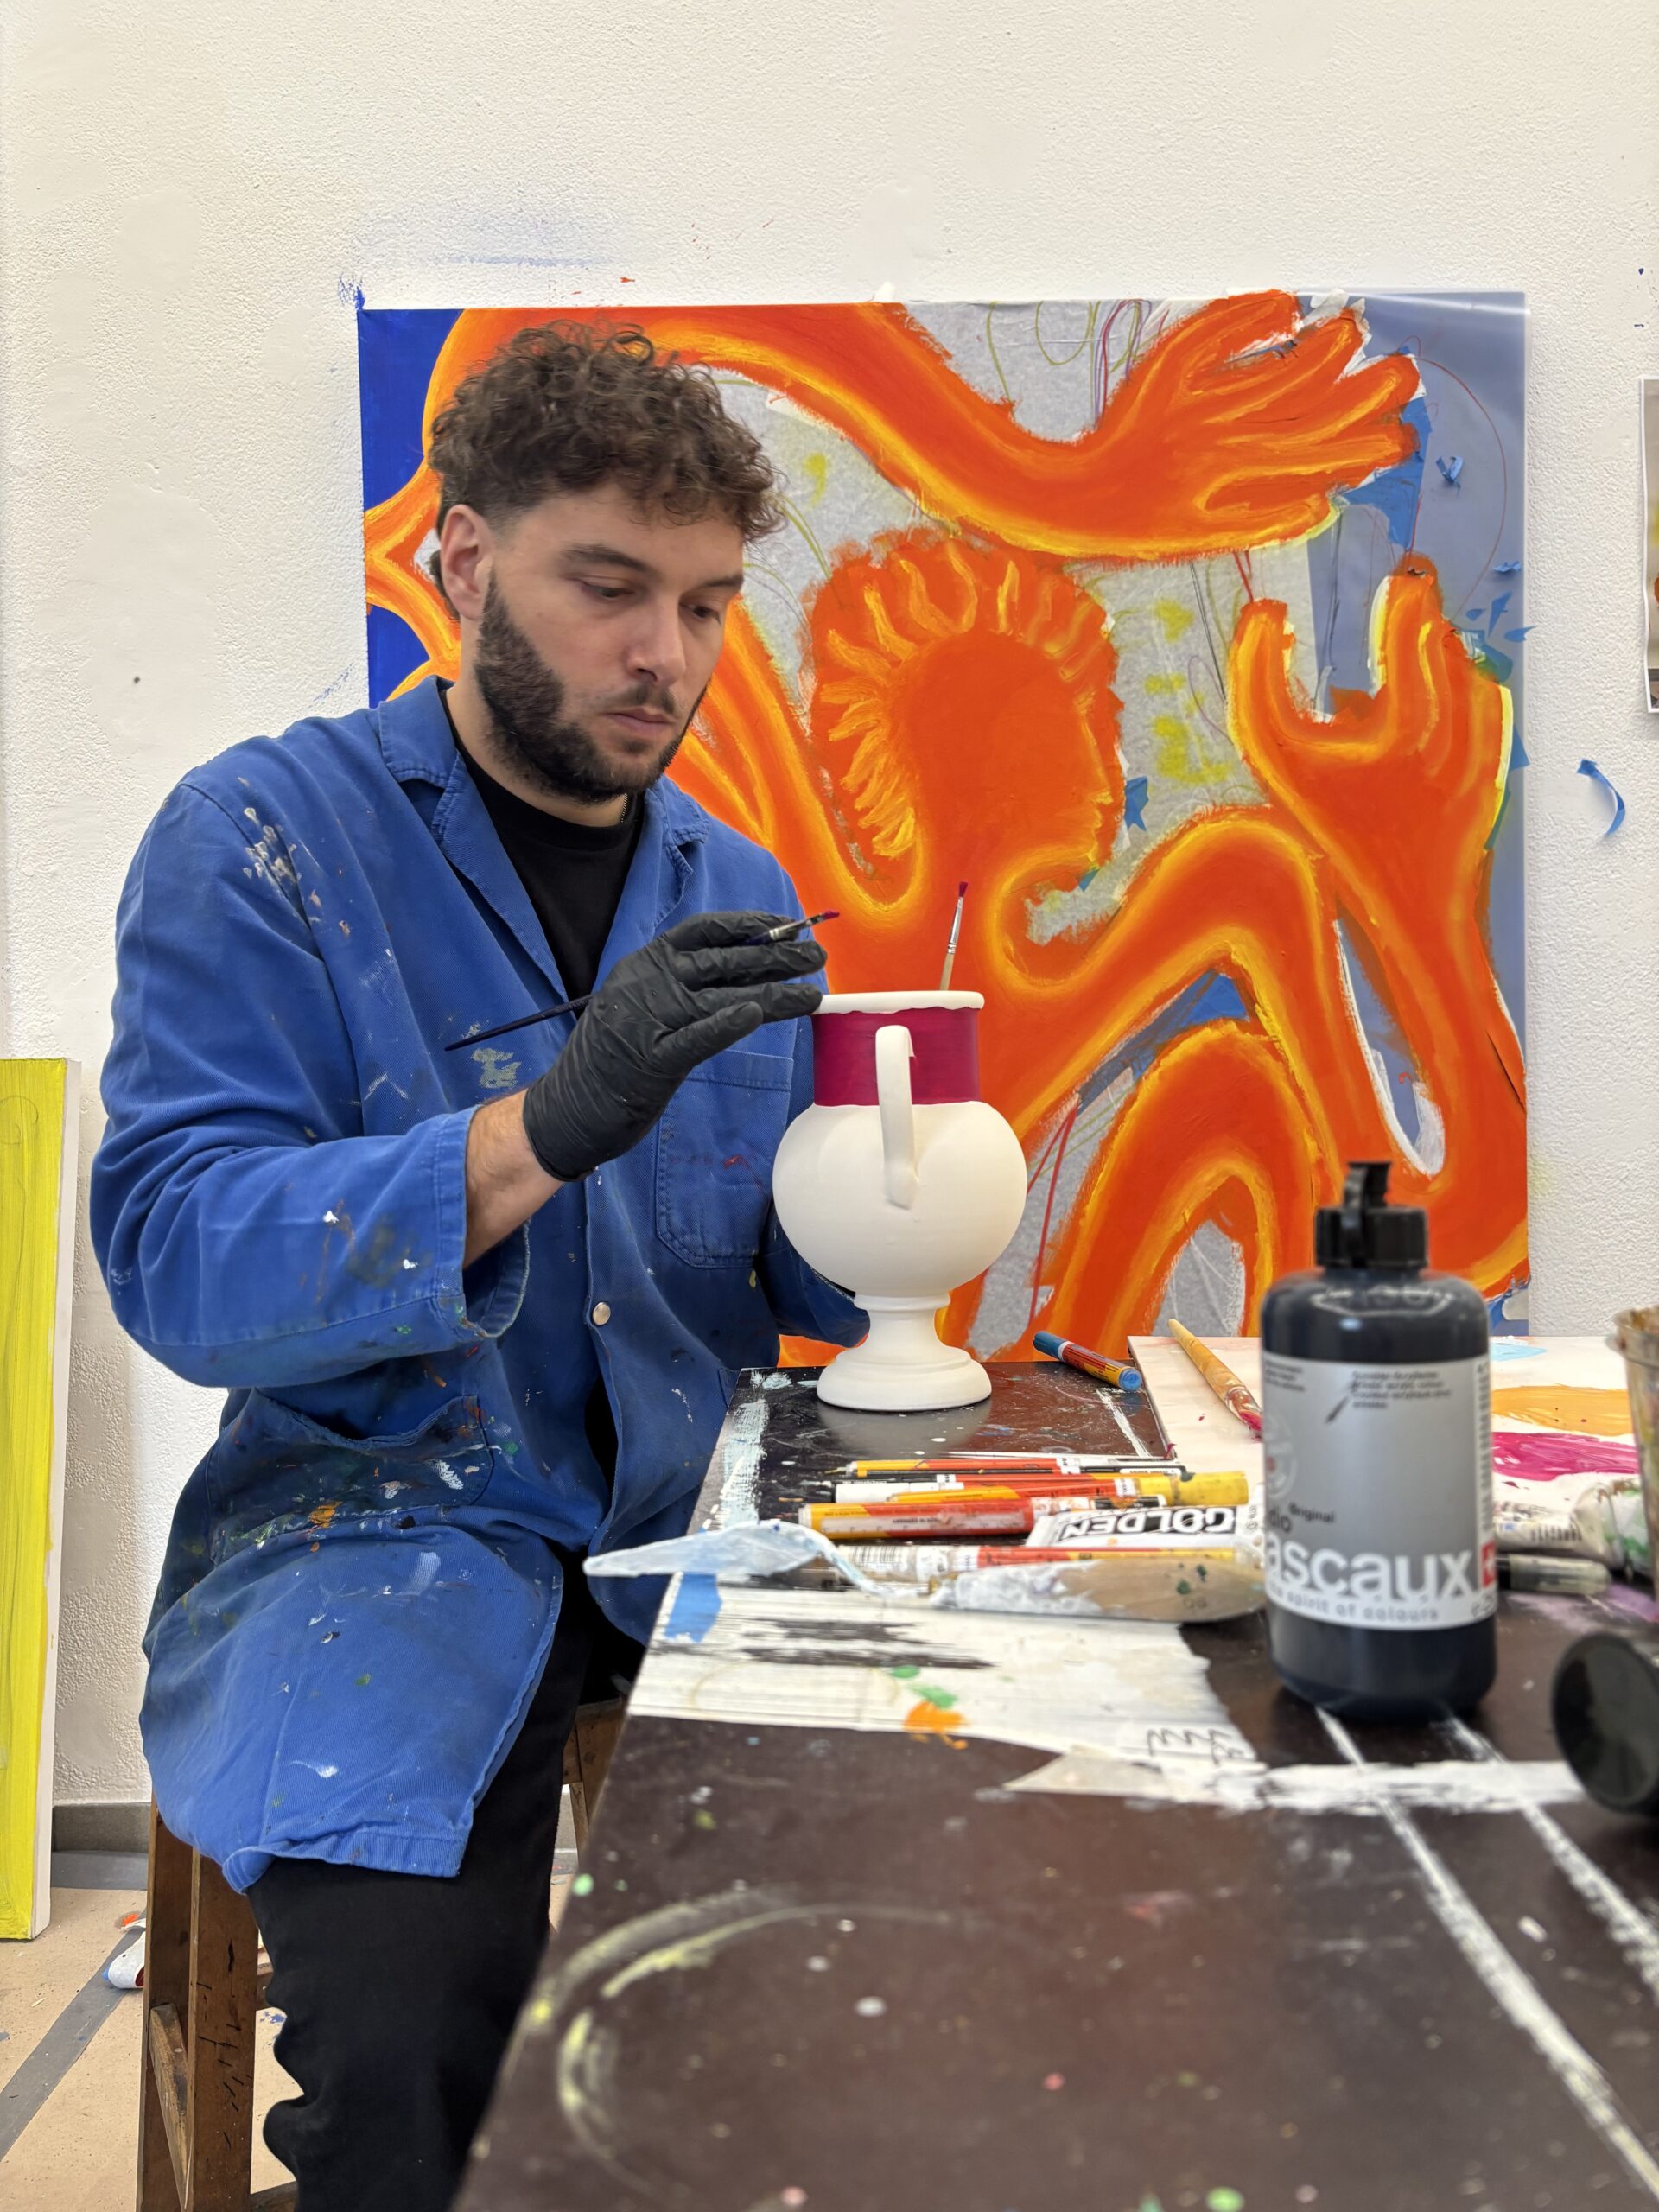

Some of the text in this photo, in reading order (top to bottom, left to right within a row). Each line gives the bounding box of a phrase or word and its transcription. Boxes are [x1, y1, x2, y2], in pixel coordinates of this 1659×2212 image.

[1063, 1507, 1235, 1538] GOLDEN
[1288, 1502, 1335, 1523] Original
[1336, 1603, 1356, 1618] of
